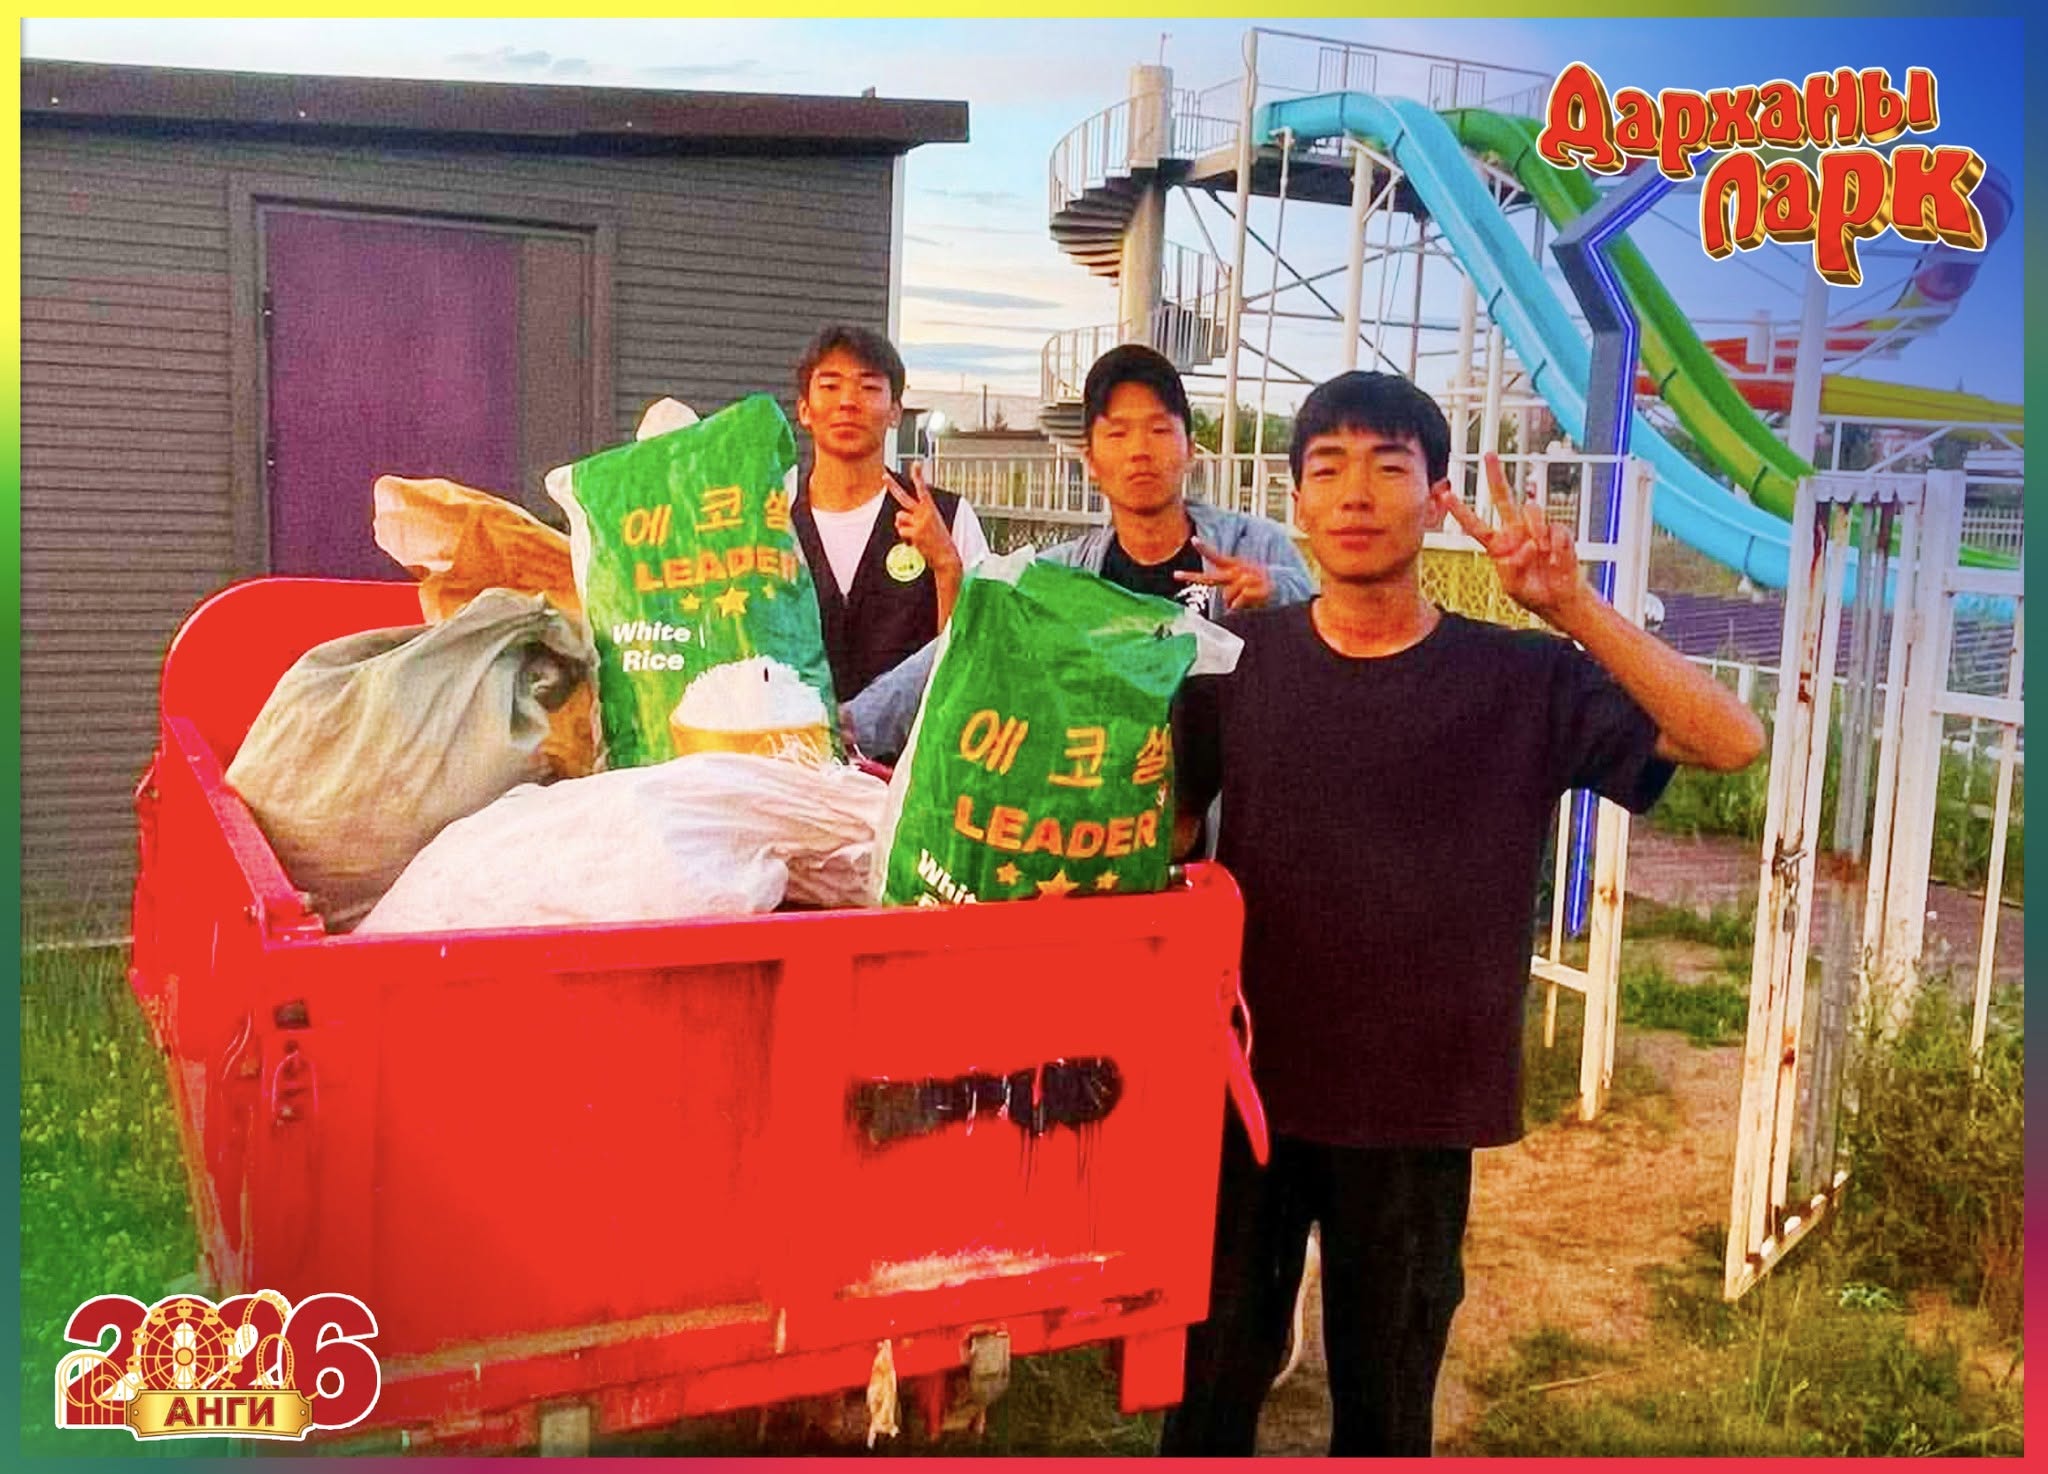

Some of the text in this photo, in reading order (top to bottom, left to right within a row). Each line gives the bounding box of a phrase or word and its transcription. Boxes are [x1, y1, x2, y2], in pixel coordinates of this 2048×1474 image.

[612, 620, 691, 645] White
[622, 649, 685, 673] Rice
[954, 795, 1157, 859] LEADER
